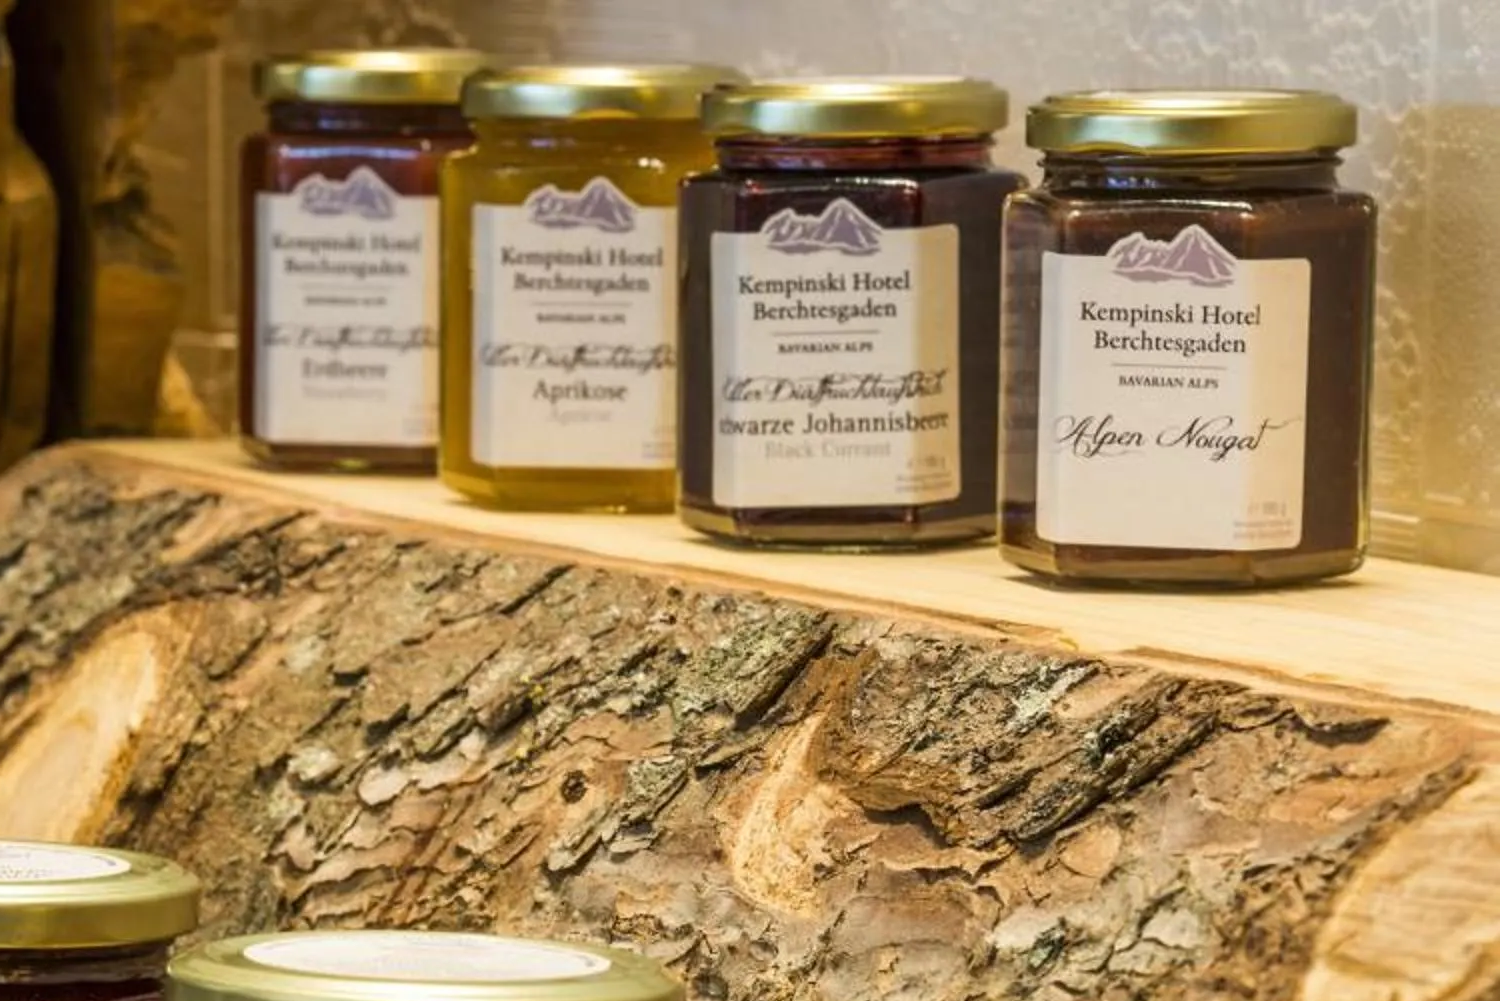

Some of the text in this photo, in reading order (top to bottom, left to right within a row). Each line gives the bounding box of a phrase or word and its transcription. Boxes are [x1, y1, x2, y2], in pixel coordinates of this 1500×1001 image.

[501, 247, 663, 270] Kempinski Hotel
[513, 272, 650, 296] Berchtesgaden
[738, 271, 911, 298] Kempinski Hotel
[753, 299, 897, 324] Berchtesgaden
[1080, 302, 1261, 327] Kempinski Hotel
[778, 342, 873, 354] BAVARIAN ALPS
[1094, 331, 1246, 357] Berchtesgaden
[532, 380, 628, 403] Aprikose
[1118, 375, 1218, 389] BAVARIAN ALPS
[1053, 414, 1299, 462] Alpen Nougat
